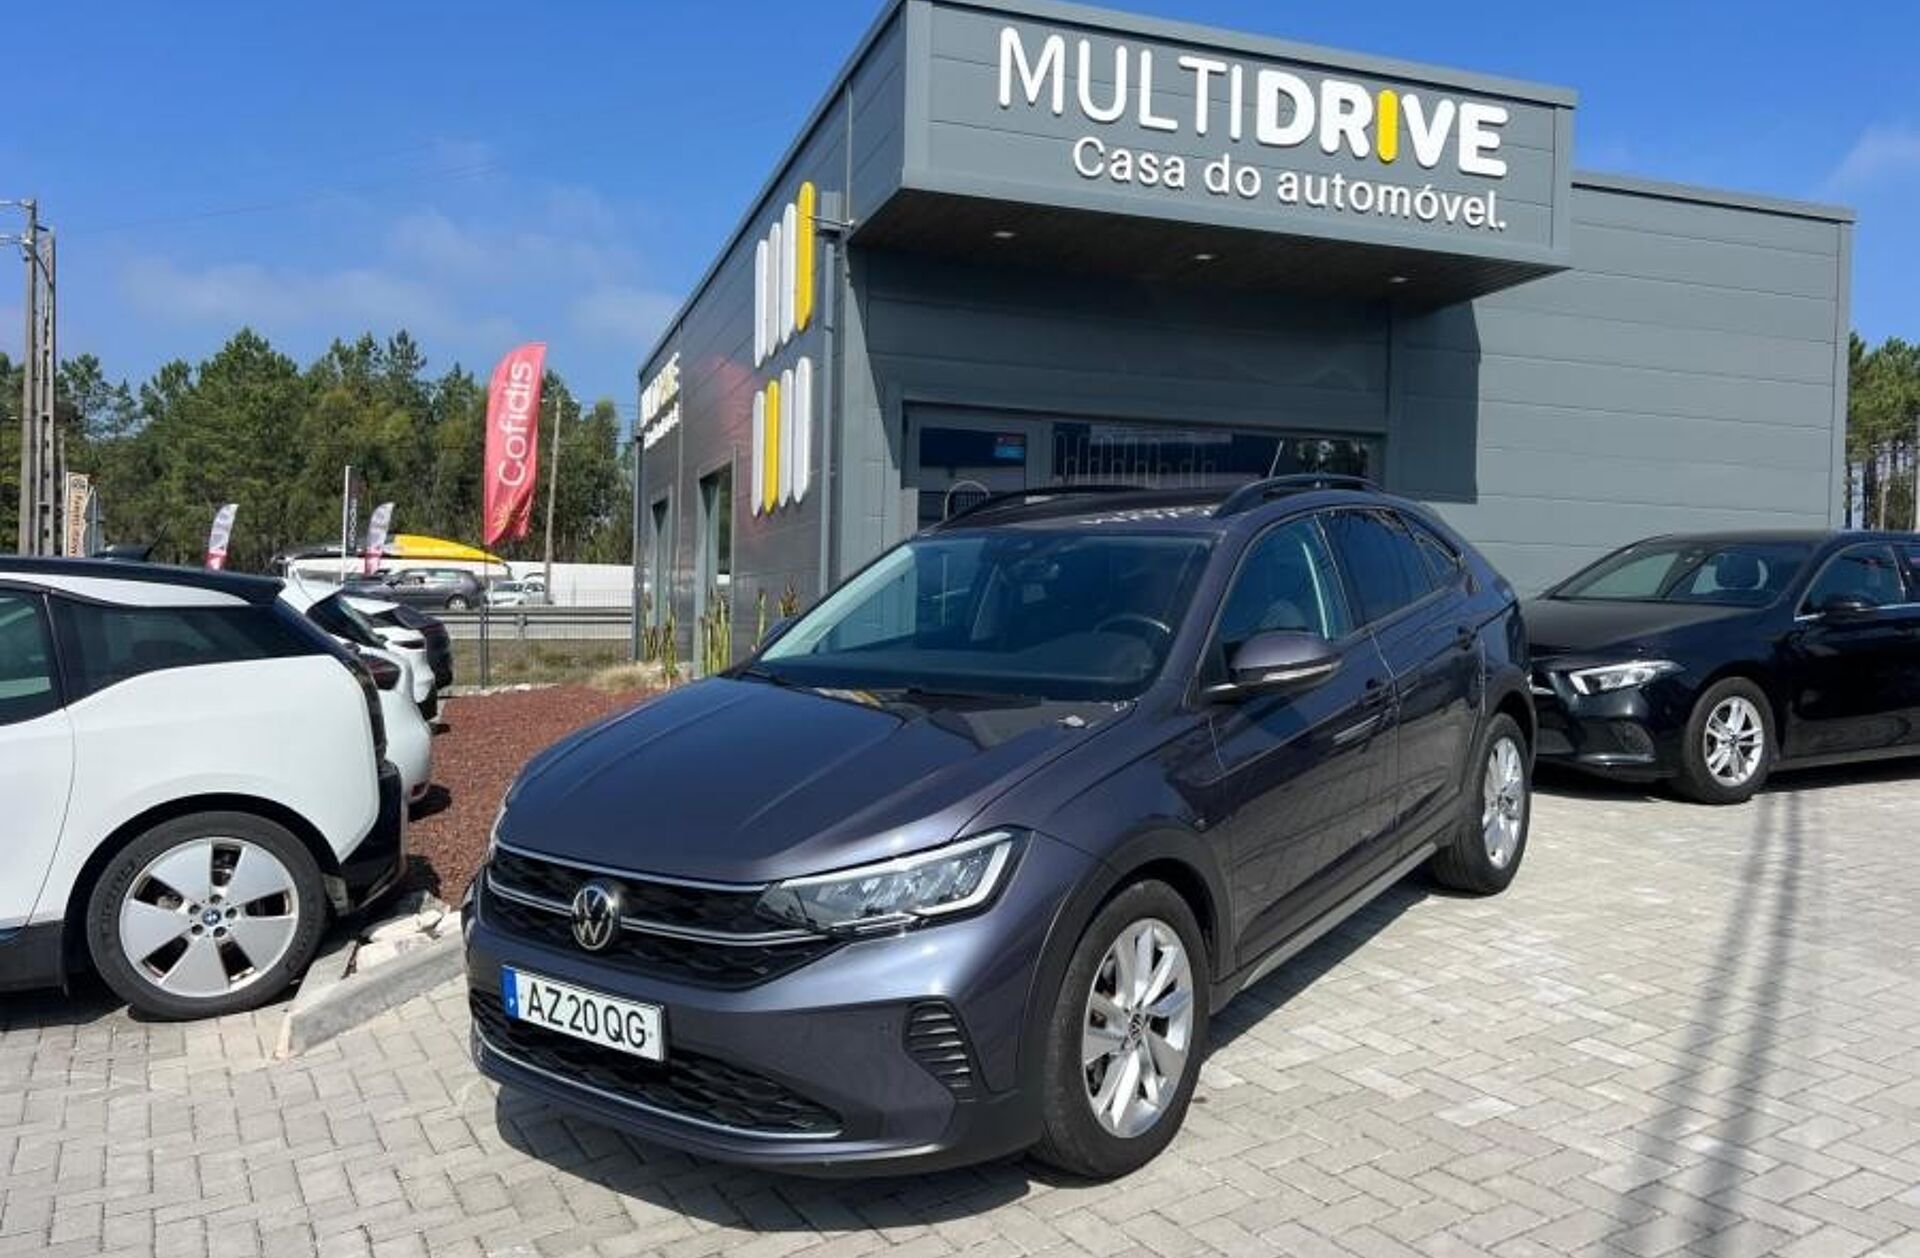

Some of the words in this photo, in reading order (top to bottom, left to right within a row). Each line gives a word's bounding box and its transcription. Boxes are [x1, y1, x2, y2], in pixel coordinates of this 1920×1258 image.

[999, 27, 1509, 177] MULTIDRIVE
[1073, 137, 1185, 189] Casa
[1204, 154, 1261, 198] do
[1277, 171, 1507, 230] automóvel.
[498, 361, 533, 487] Cofidis
